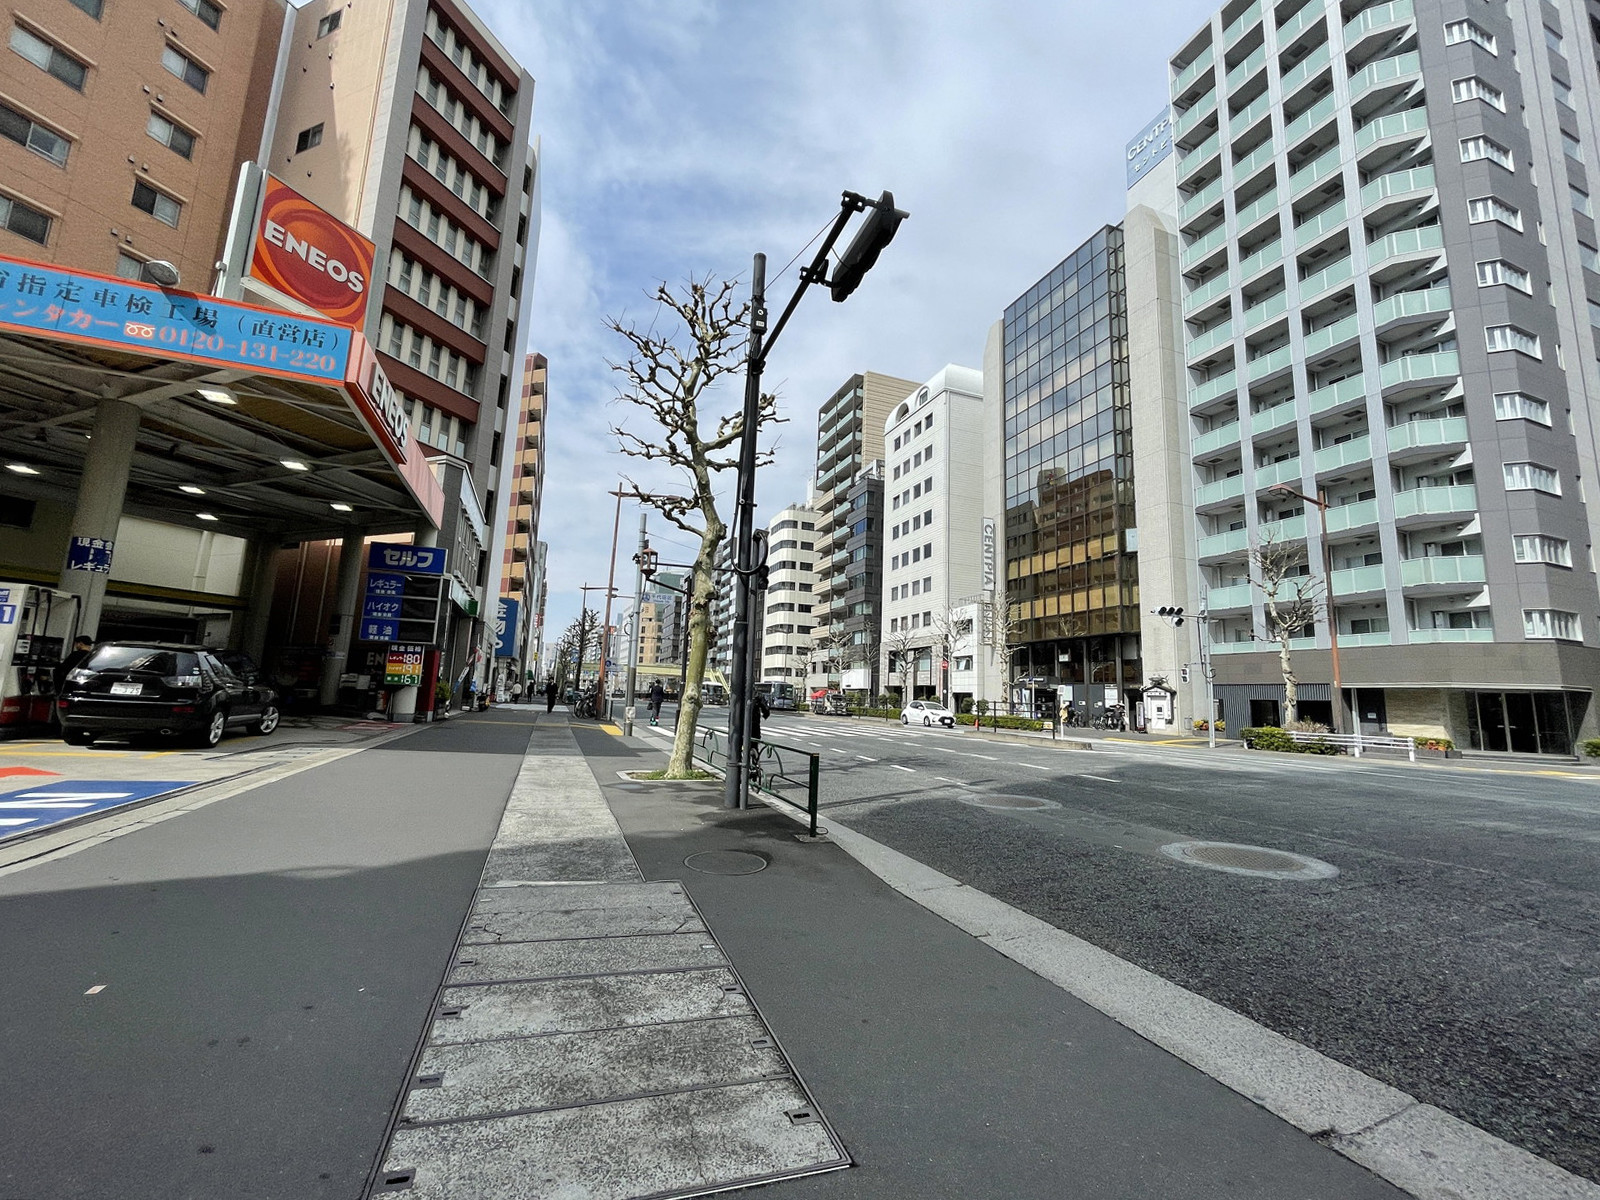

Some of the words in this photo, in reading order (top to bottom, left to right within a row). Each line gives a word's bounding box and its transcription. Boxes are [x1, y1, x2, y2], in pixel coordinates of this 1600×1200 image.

[264, 219, 364, 293] ENEOS
[158, 325, 337, 373] 0120-131-220
[371, 362, 409, 448] ENEOS
[383, 548, 434, 568] セルフ
[984, 524, 994, 585] CENTPIA
[369, 579, 402, 589] レギュラー
[3, 606, 12, 622] 1
[367, 602, 399, 612] ハイオク
[403, 653, 420, 665] 180
[402, 664, 418, 674] 191
[401, 674, 418, 685] 167
